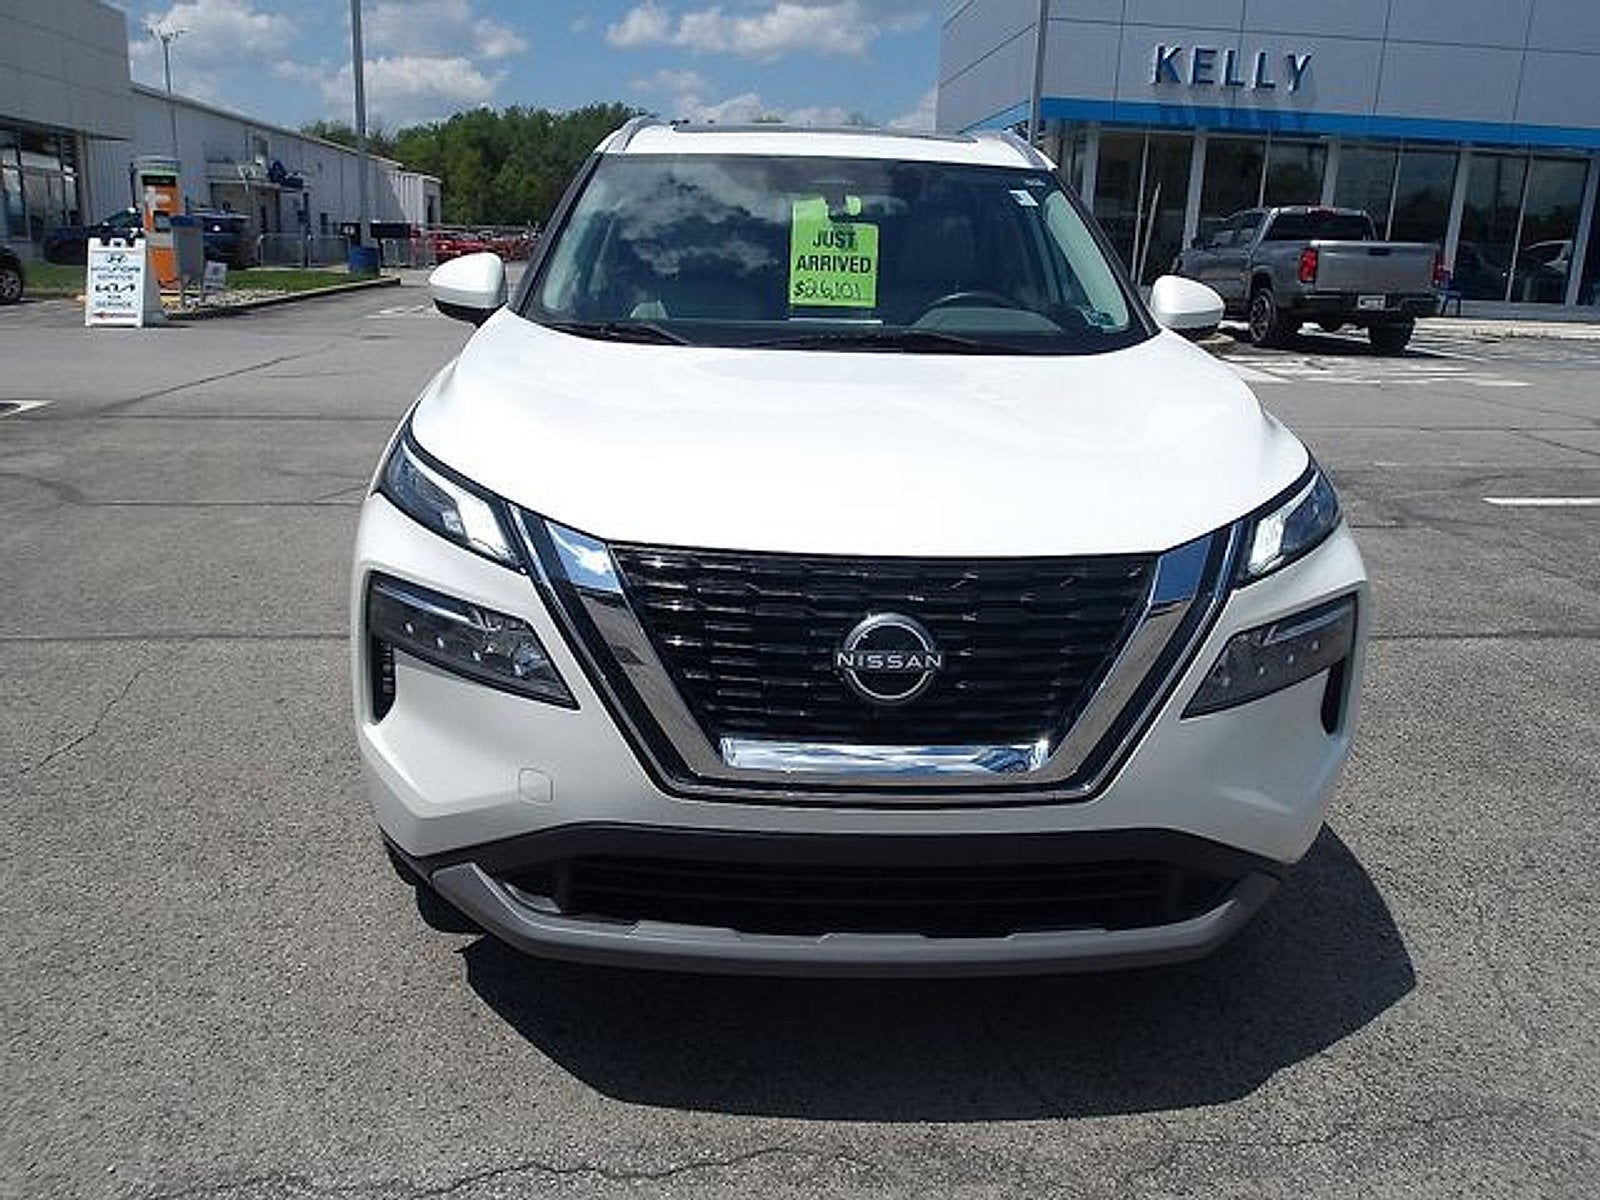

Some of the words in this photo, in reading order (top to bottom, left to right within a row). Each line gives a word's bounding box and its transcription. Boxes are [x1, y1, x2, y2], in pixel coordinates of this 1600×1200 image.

[1152, 43, 1312, 91] KELLY
[812, 230, 857, 249] JUST
[796, 255, 872, 274] ARRIVED
[837, 652, 942, 669] NISSAN
